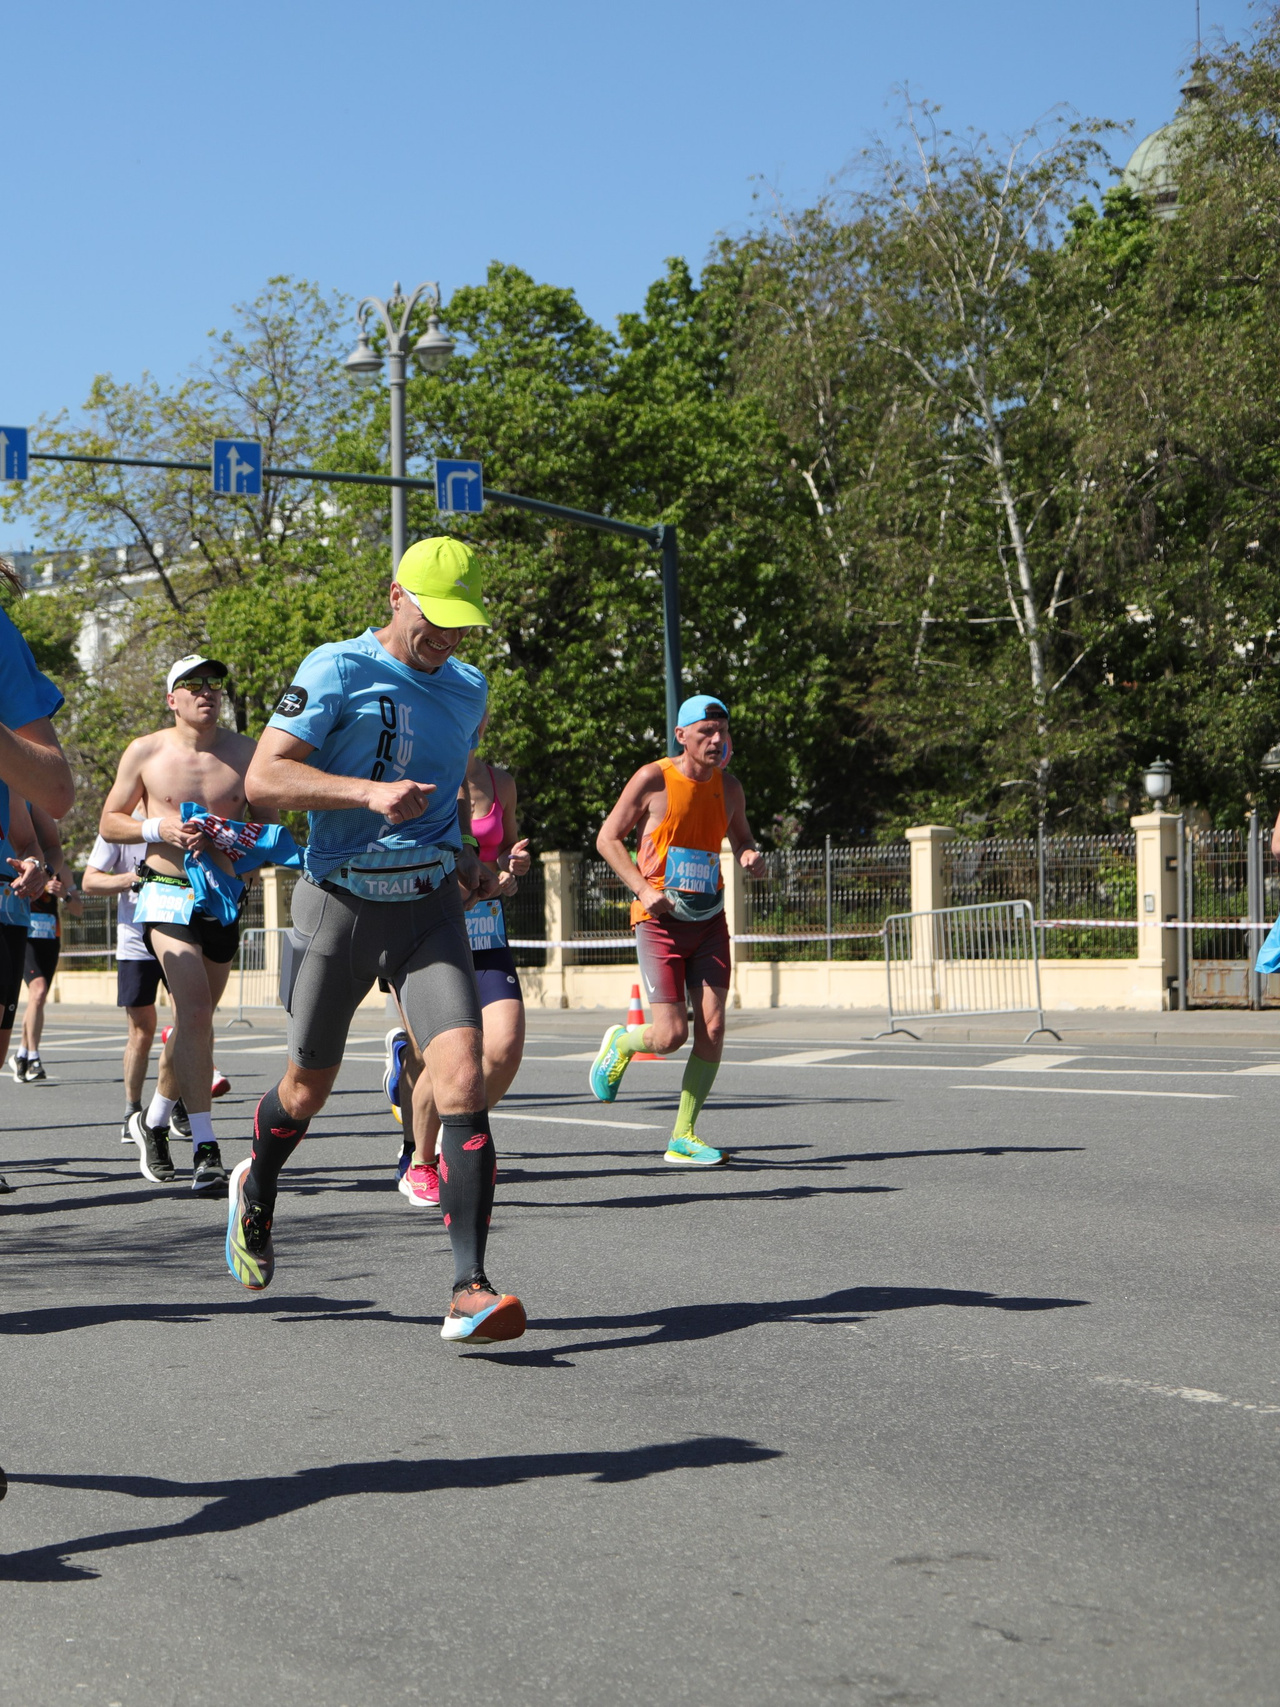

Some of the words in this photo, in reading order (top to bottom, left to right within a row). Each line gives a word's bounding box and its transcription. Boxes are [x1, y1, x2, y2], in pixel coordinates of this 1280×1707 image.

[370, 696, 397, 781] PRO
[365, 877, 420, 896] TRAIL
[679, 878, 705, 893] 21.1KM
[465, 916, 495, 935] 2700
[598, 1048, 615, 1076] HOKA
